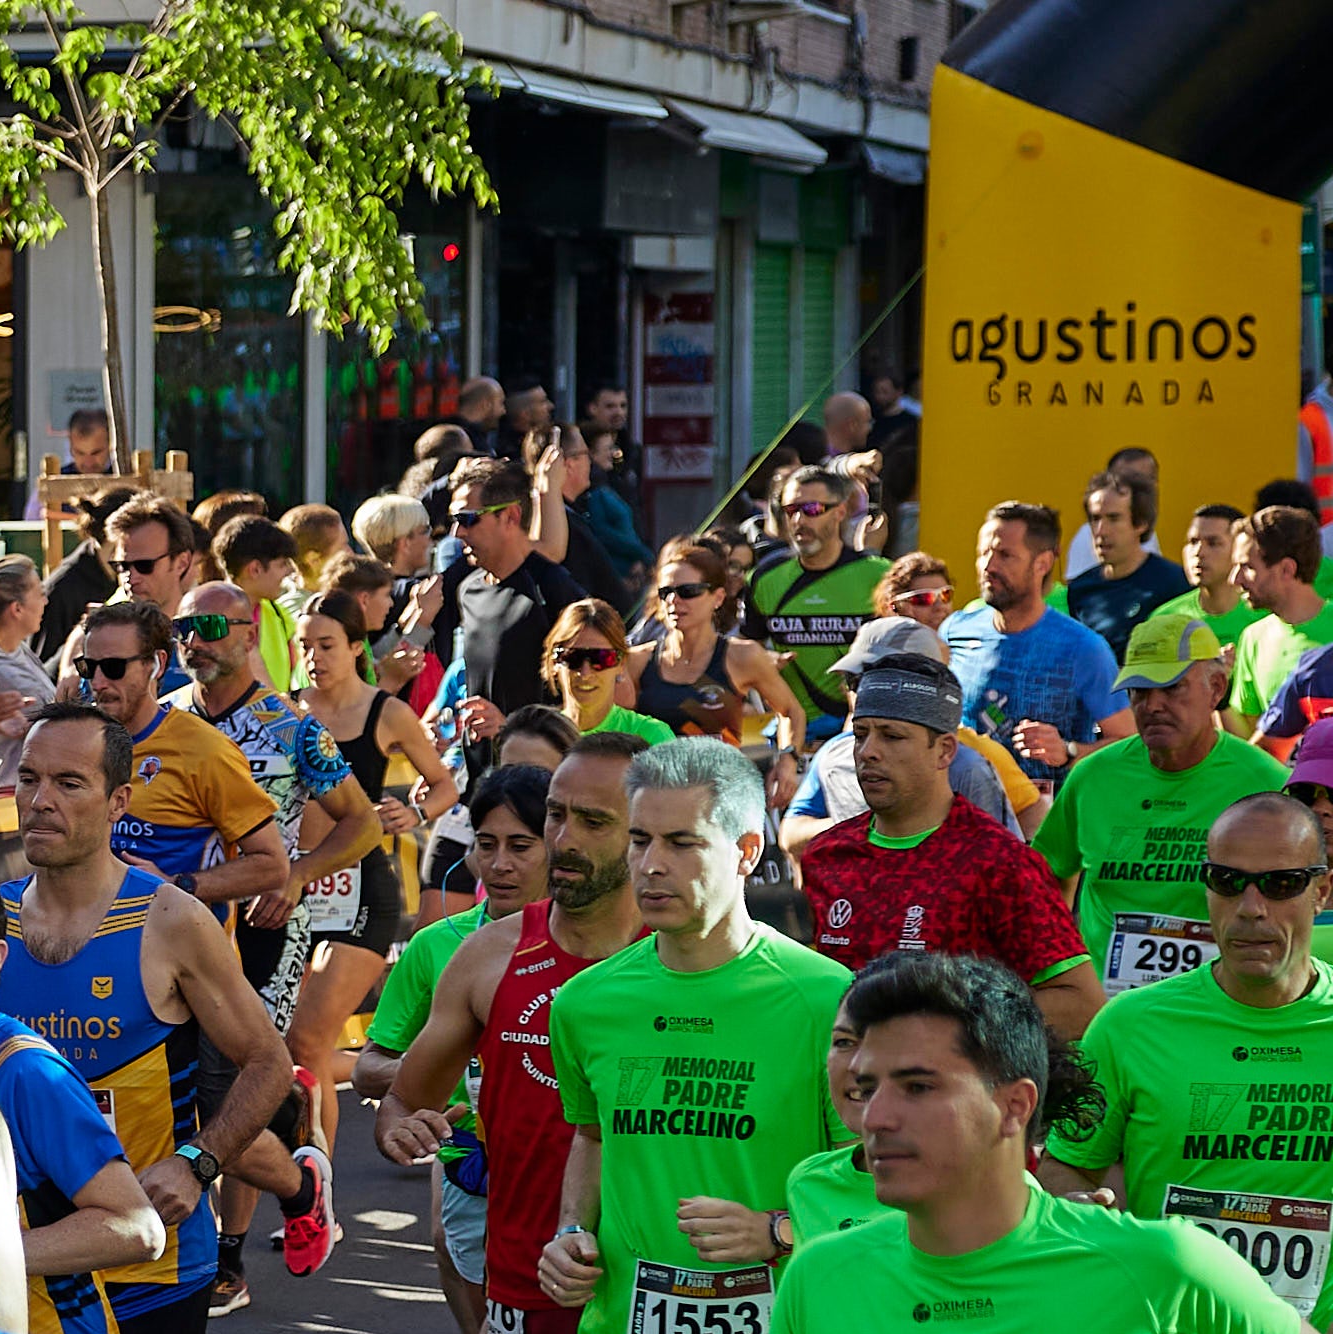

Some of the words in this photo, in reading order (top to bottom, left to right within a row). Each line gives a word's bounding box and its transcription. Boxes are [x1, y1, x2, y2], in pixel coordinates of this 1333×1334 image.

[951, 301, 1258, 381] agustinos
[987, 379, 1215, 407] GRANADA
[770, 616, 806, 633] CAJA
[787, 631, 846, 644] GRANADA
[1135, 938, 1203, 974] 299
[518, 993, 548, 1025] CLUB
[669, 1016, 715, 1026] OXIMESA
[500, 1031, 550, 1046] CIUDAD
[1250, 1046, 1302, 1056] OXIMESA
[661, 1056, 756, 1083] MEMORIAL
[662, 1079, 749, 1110] PADRE
[612, 1108, 757, 1141] MARCELINO
[1246, 1104, 1333, 1132] PADR
[933, 1297, 994, 1313] OXIMESA
